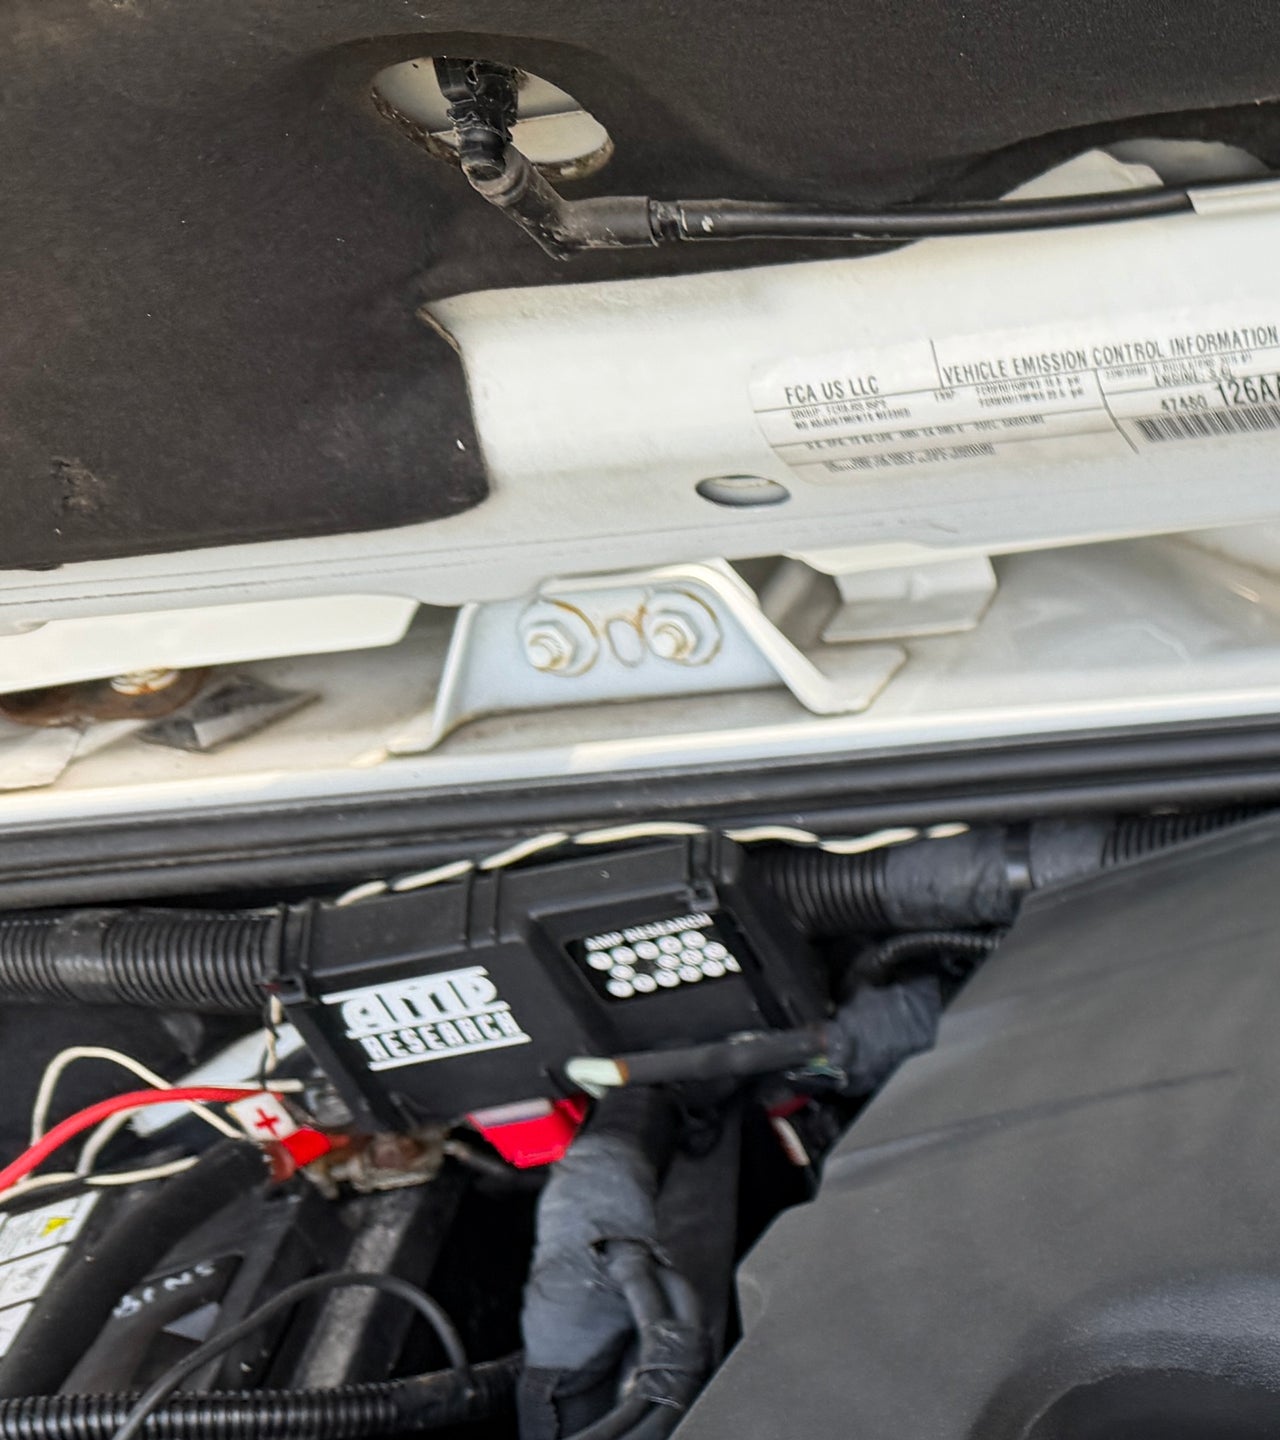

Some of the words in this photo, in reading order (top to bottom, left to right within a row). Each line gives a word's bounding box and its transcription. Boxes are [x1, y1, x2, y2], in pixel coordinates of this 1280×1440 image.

[943, 359, 1009, 385] VEHICLE
[1012, 350, 1088, 377] EMISSION
[1093, 339, 1165, 367] CONTROL
[1169, 325, 1279, 355] INFORMATION
[784, 384, 818, 405] FCA
[821, 380, 845, 400] US
[848, 375, 879, 397] LLC
[360, 1009, 525, 1062] RESEARCH
